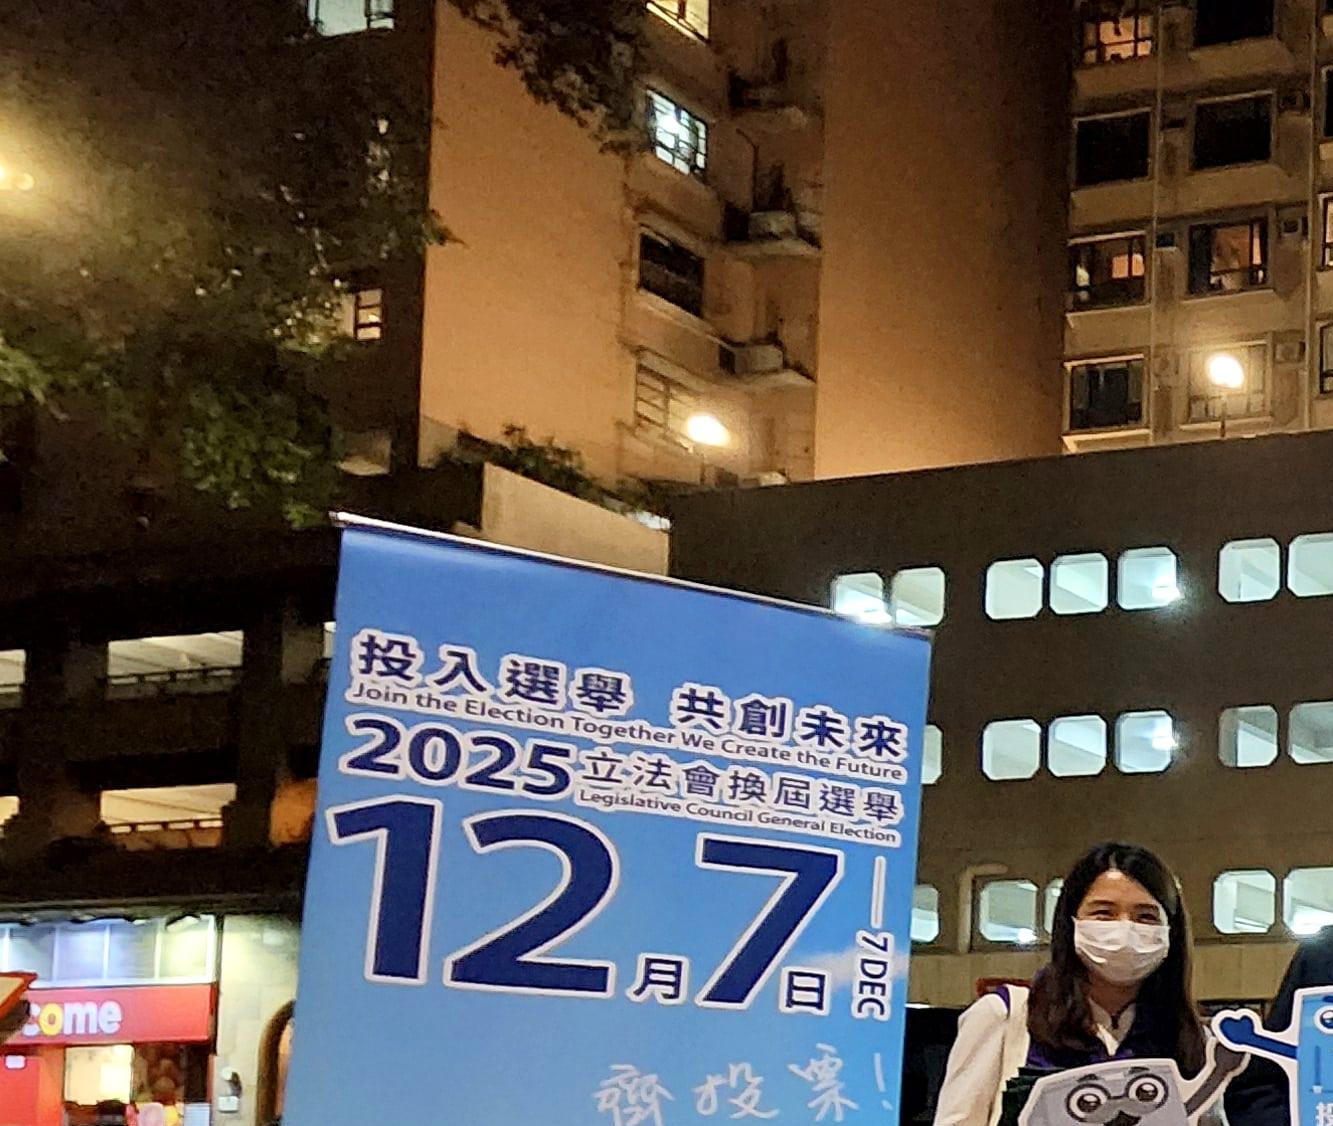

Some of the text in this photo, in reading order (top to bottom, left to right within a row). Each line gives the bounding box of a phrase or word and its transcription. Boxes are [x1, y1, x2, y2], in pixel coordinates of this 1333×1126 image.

[352, 681, 903, 780] Join the Election Together We Create the Future
[357, 632, 902, 759] 投入選舉 共創未來
[346, 718, 899, 822] 2025 立法會換屆選舉
[580, 789, 897, 843] Legislative Council General Election
[857, 936, 889, 1016] 7 DEC
